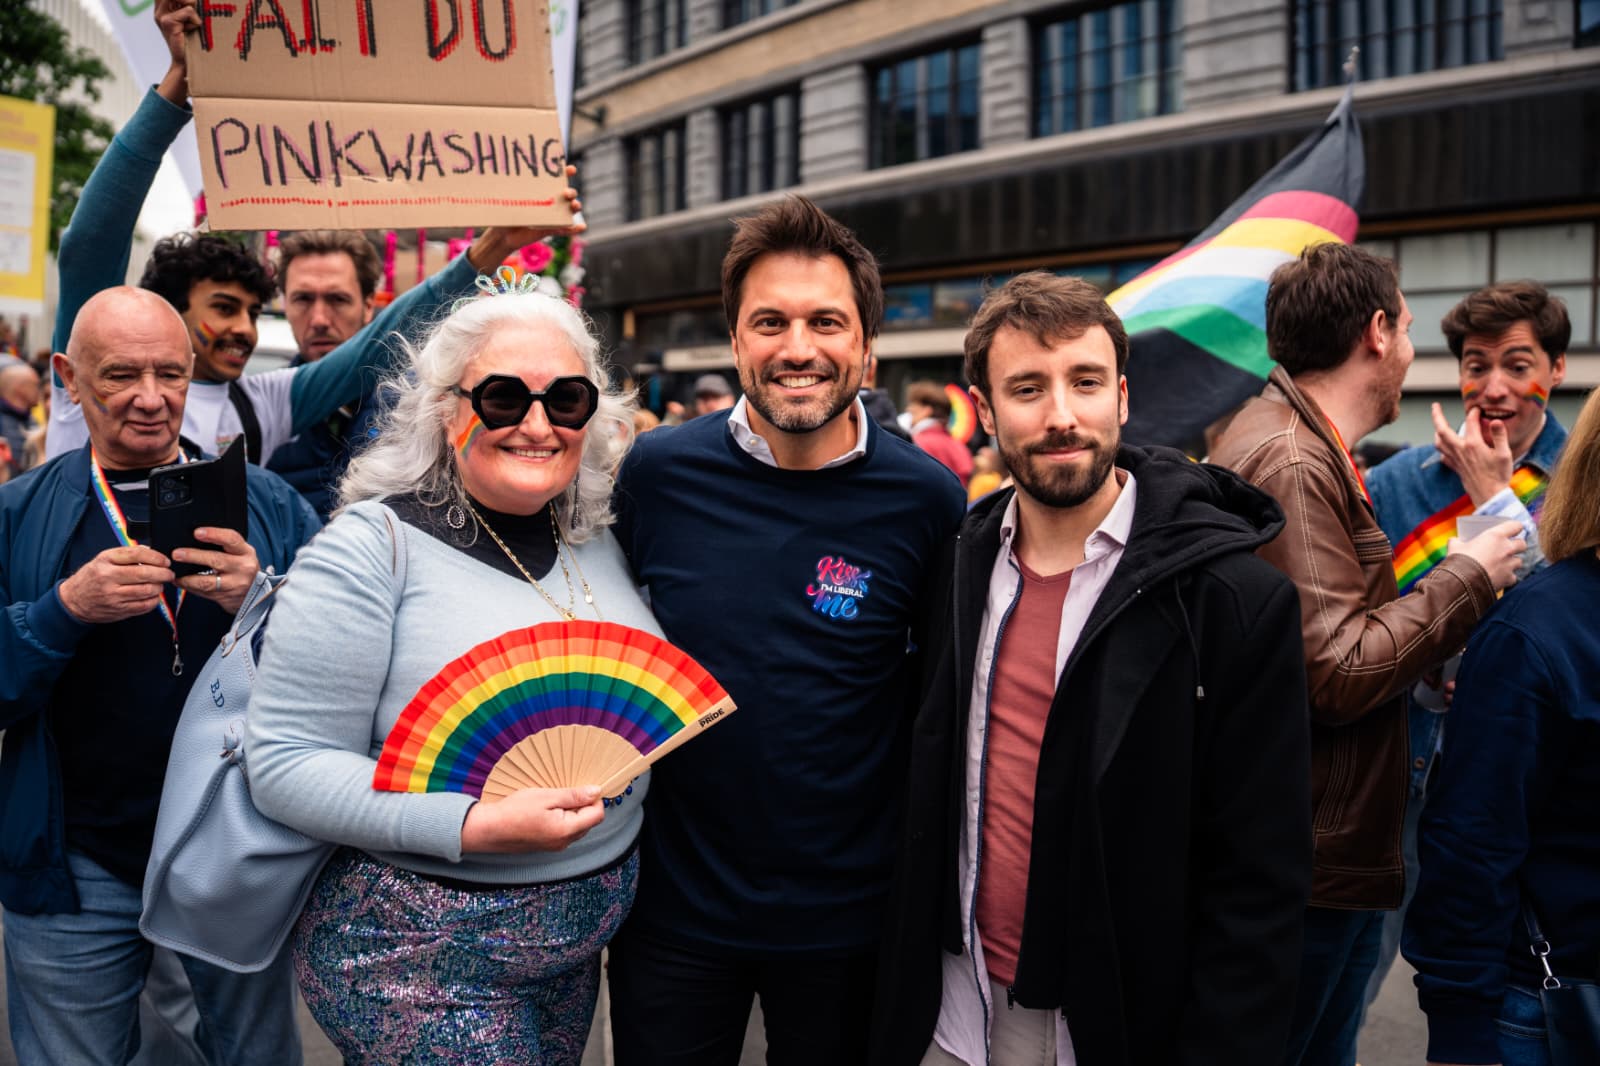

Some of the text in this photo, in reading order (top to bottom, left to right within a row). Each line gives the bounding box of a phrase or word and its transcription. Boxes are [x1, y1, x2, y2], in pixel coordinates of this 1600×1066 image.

[424, 0, 517, 62] DU
[210, 117, 566, 189] PINKWASHING
[817, 555, 872, 589] Kiss
[806, 584, 858, 618] me
[833, 585, 864, 599] LIBERAL
[699, 707, 725, 728] PRIDE
